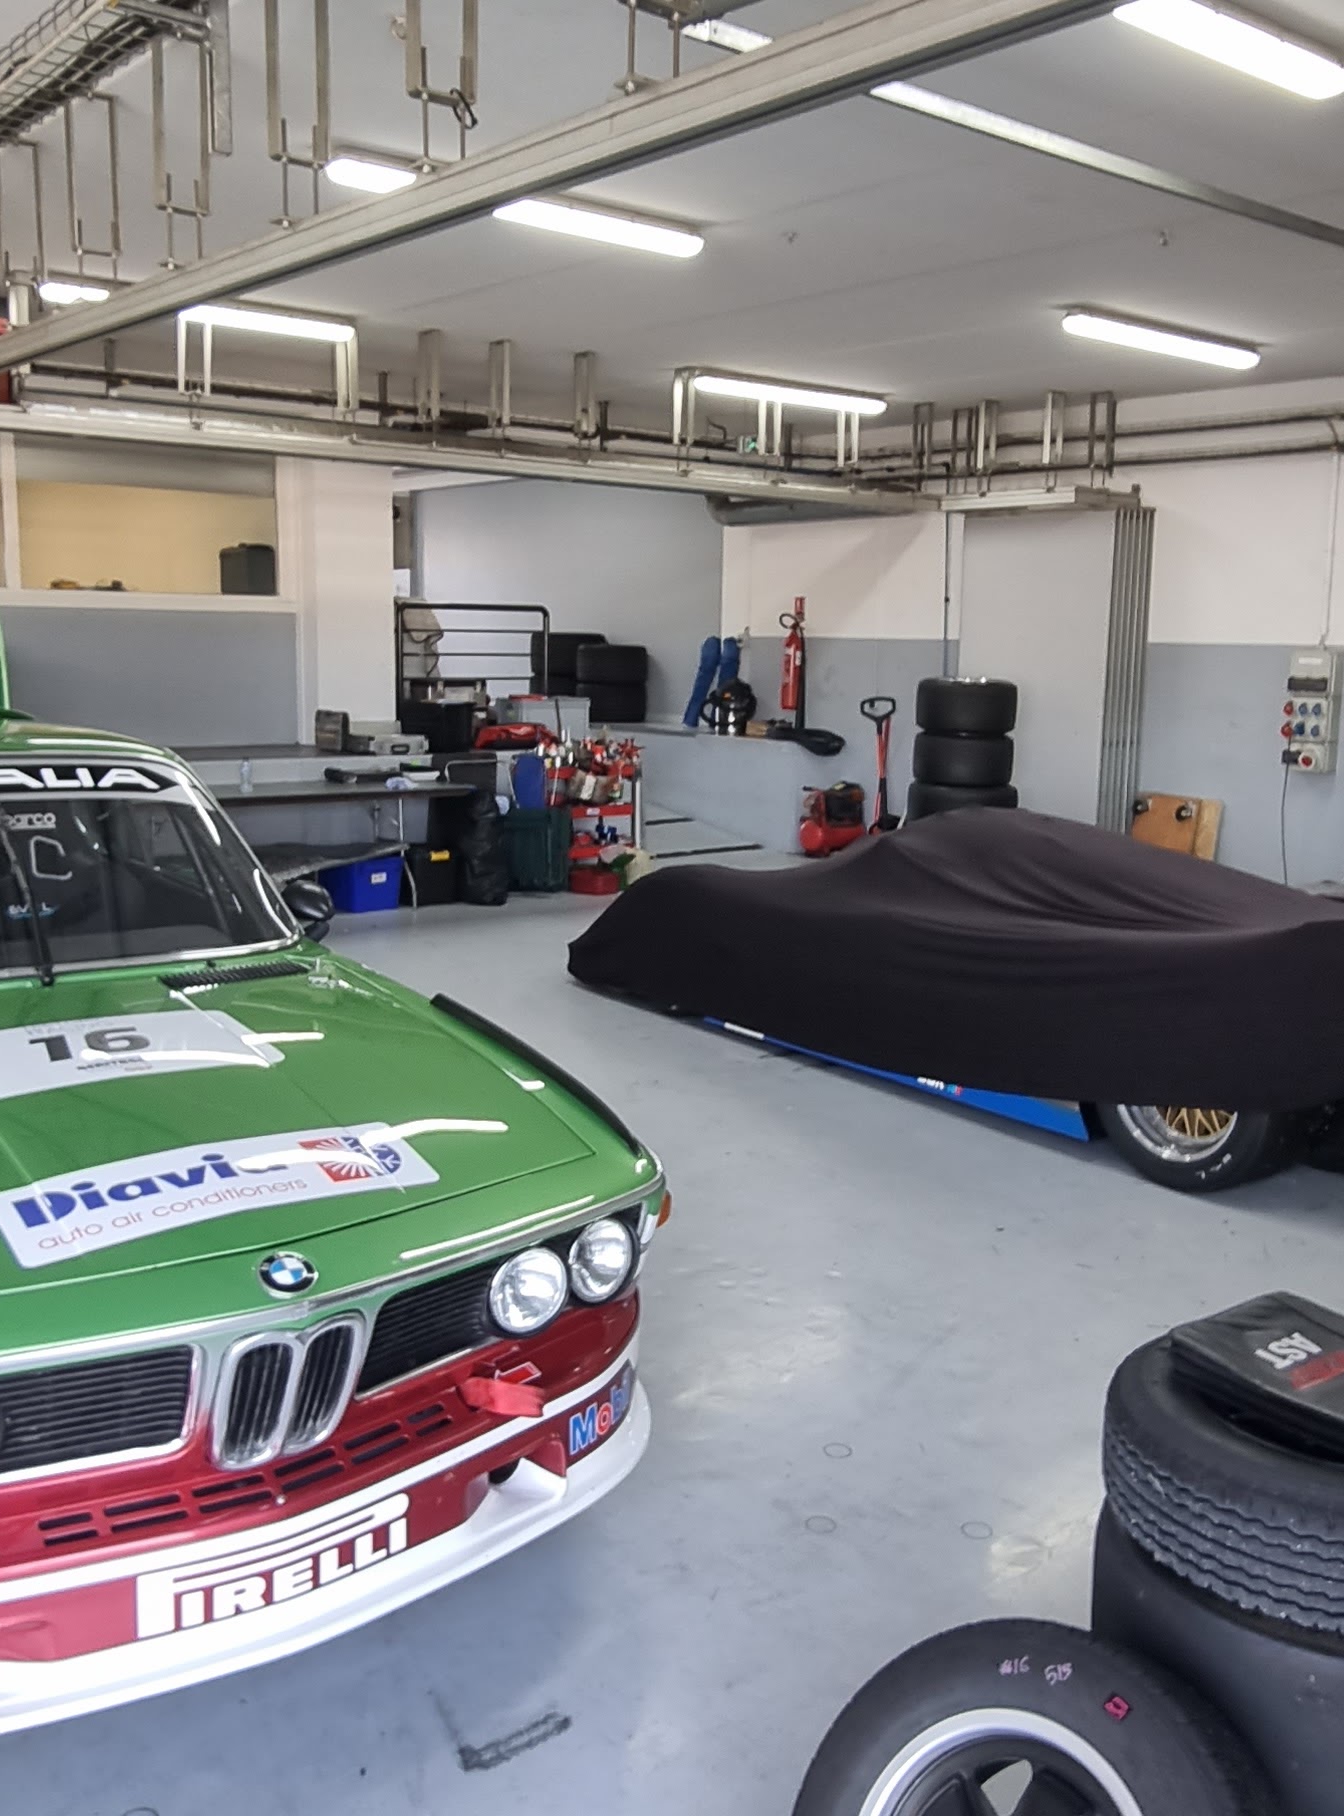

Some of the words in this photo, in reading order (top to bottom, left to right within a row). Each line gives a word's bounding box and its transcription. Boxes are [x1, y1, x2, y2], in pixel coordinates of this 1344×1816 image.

[28, 1026, 151, 1062] 16
[38, 1222, 104, 1251] auto
[110, 1208, 143, 1230] air
[151, 1177, 309, 1218] conditioners
[1253, 1331, 1323, 1370] AST
[136, 1491, 409, 1641] PIRELLI
